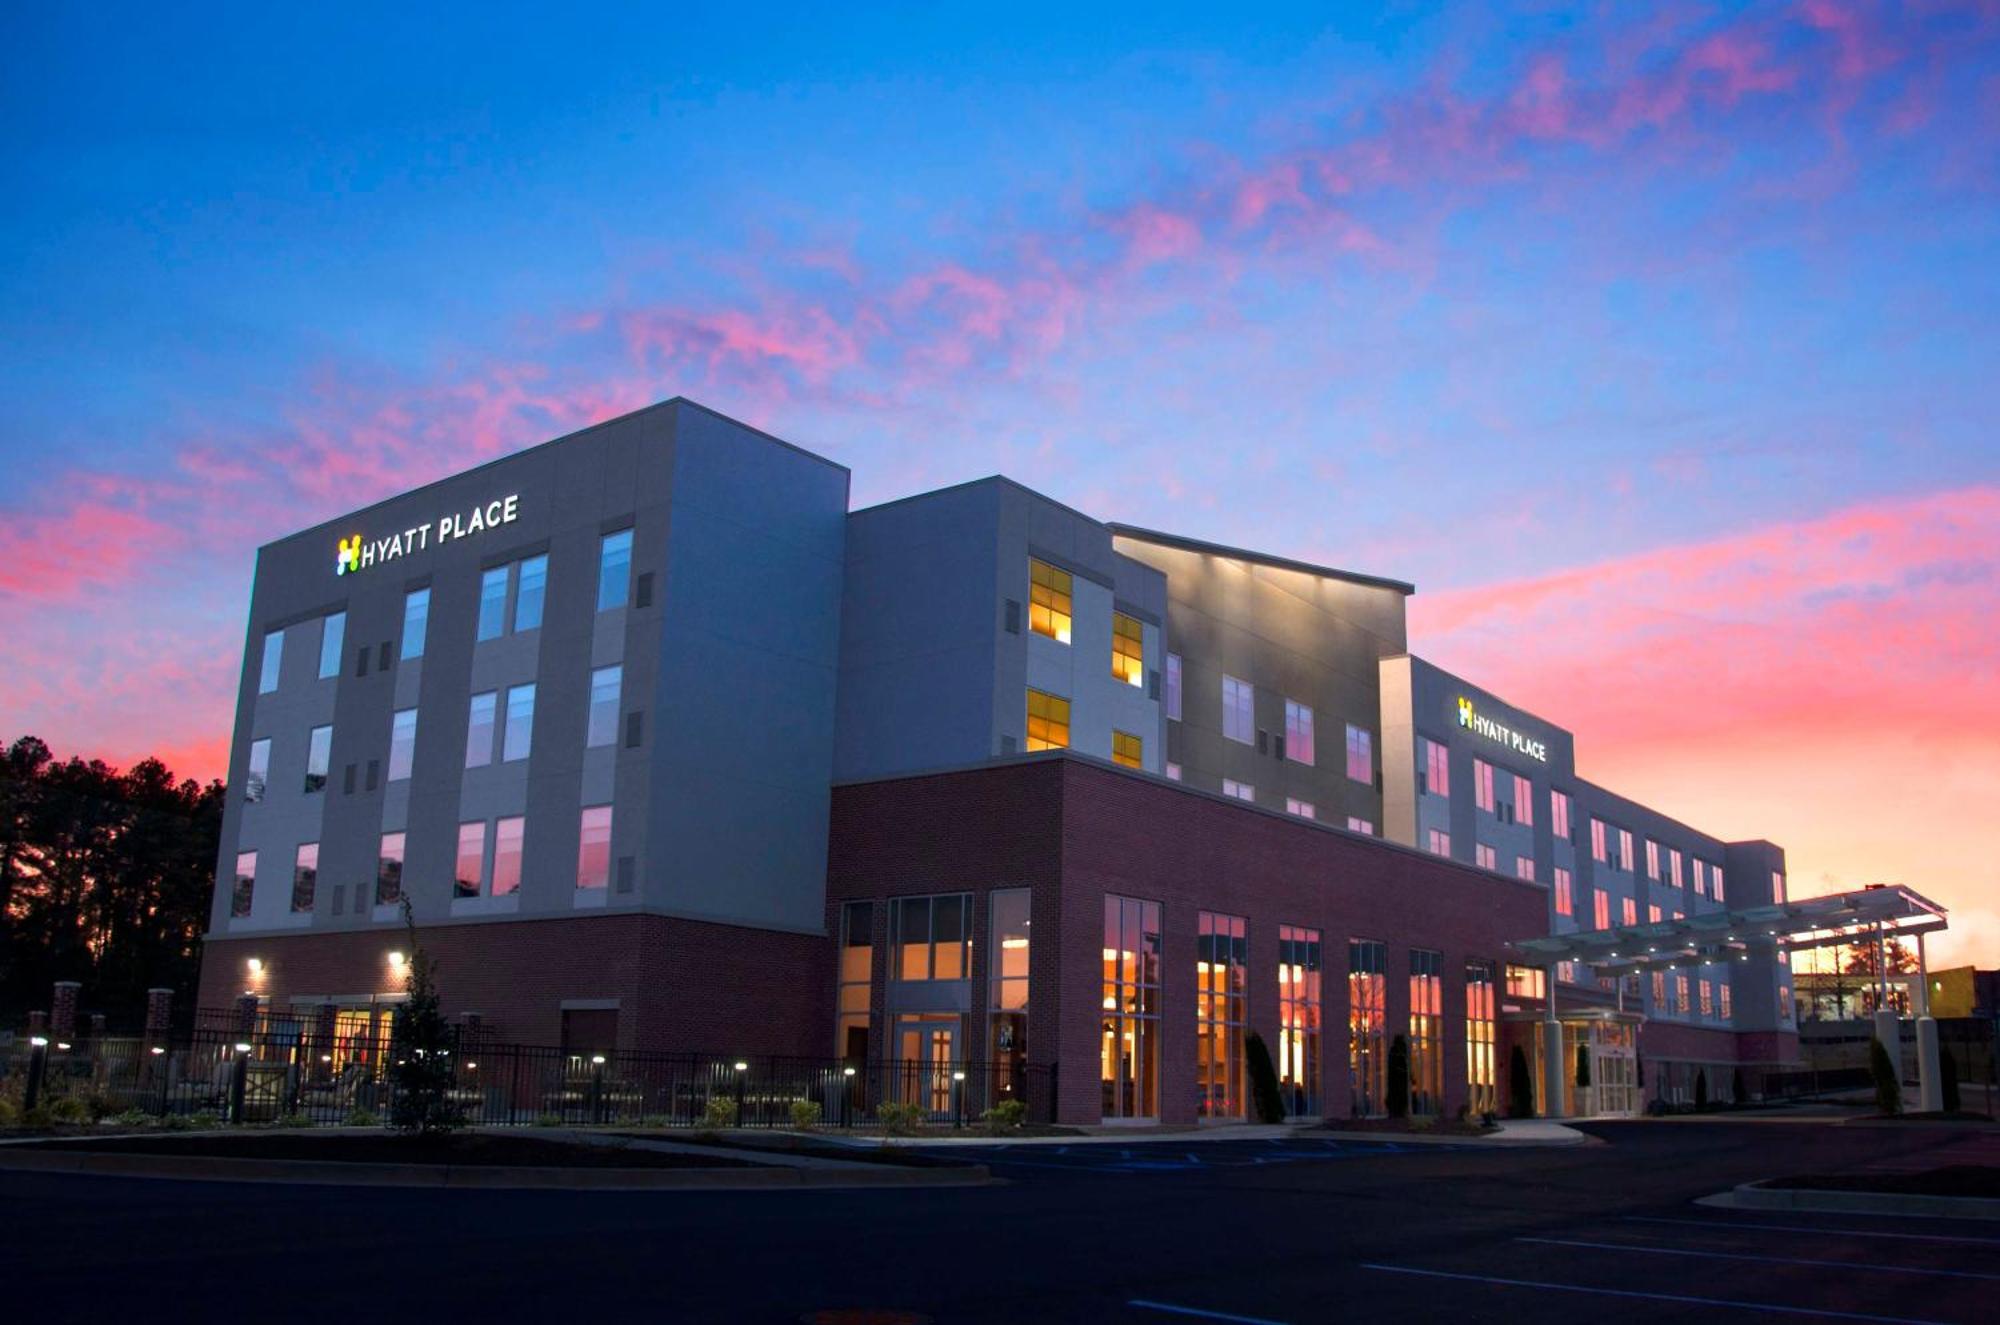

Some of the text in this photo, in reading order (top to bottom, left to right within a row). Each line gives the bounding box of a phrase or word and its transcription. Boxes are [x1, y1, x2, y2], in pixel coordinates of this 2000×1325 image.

[361, 495, 518, 568] HYATT PLACE
[1473, 713, 1546, 762] HYATT PLACE
